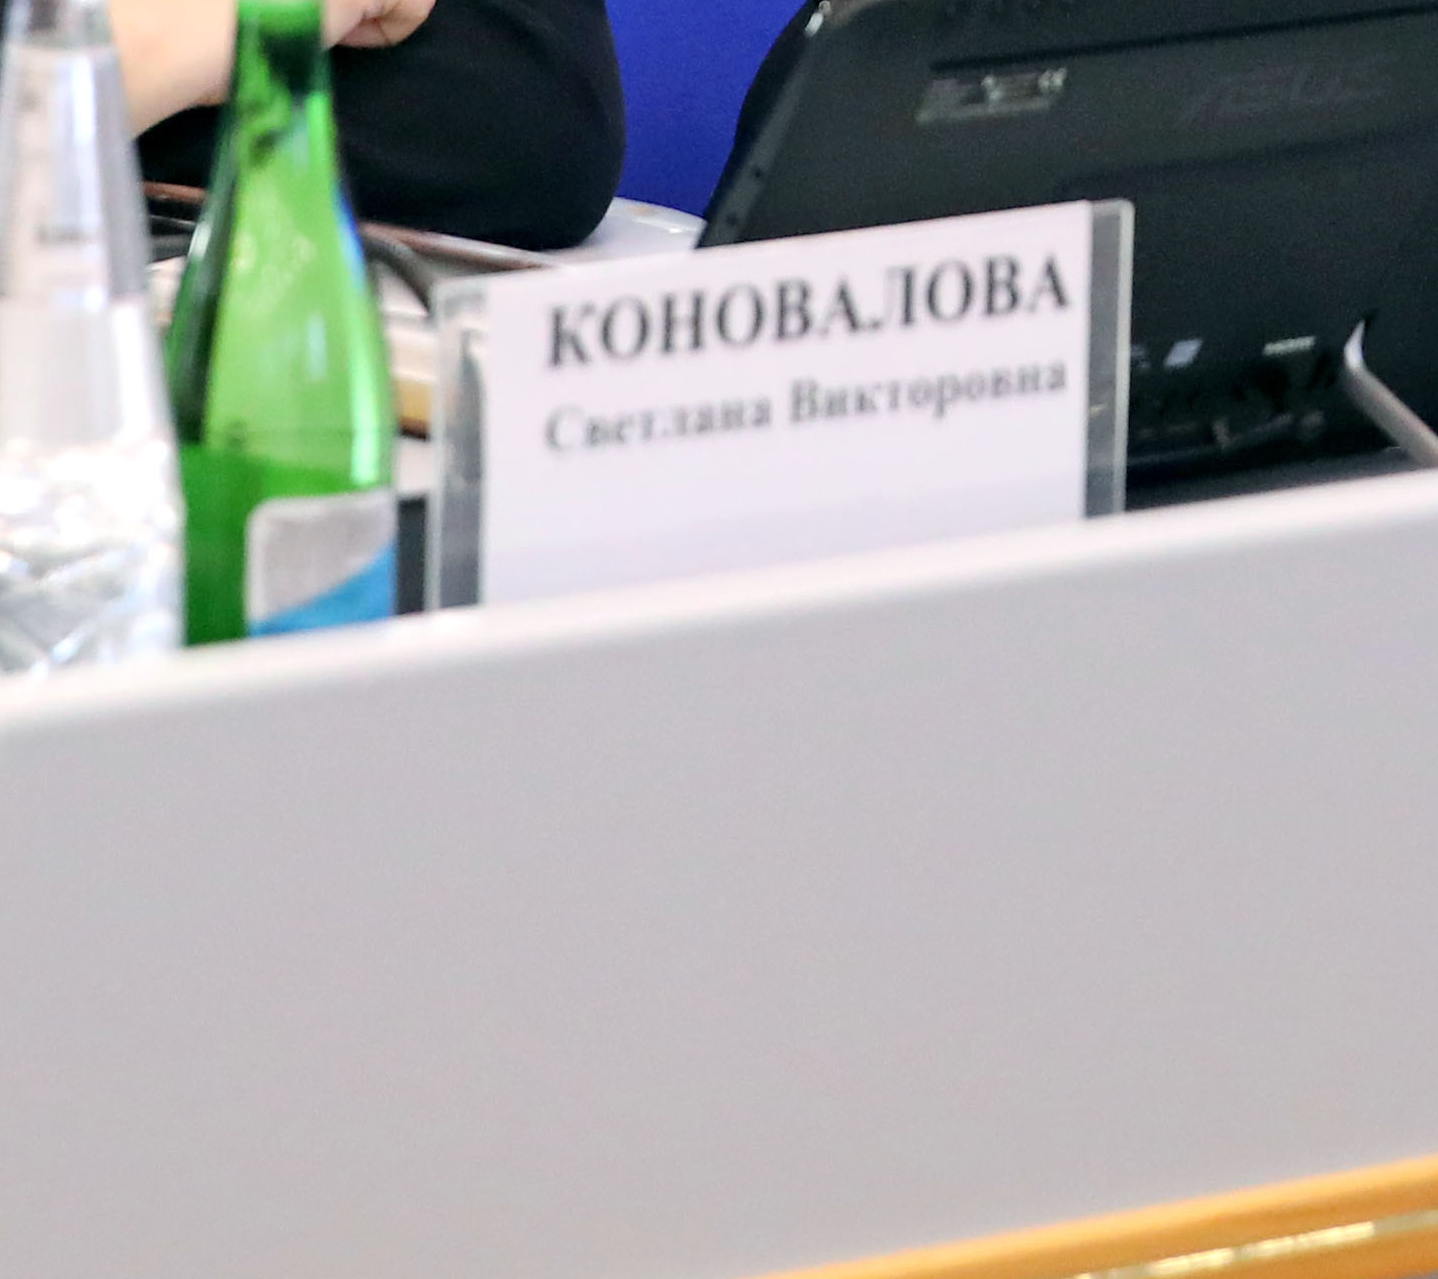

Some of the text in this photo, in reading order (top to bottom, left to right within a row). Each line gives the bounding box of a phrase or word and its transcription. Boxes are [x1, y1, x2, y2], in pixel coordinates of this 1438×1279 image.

[545, 251, 1070, 369] КОНОВАЛОВА
[543, 356, 1068, 453] Светлана Викторовна
